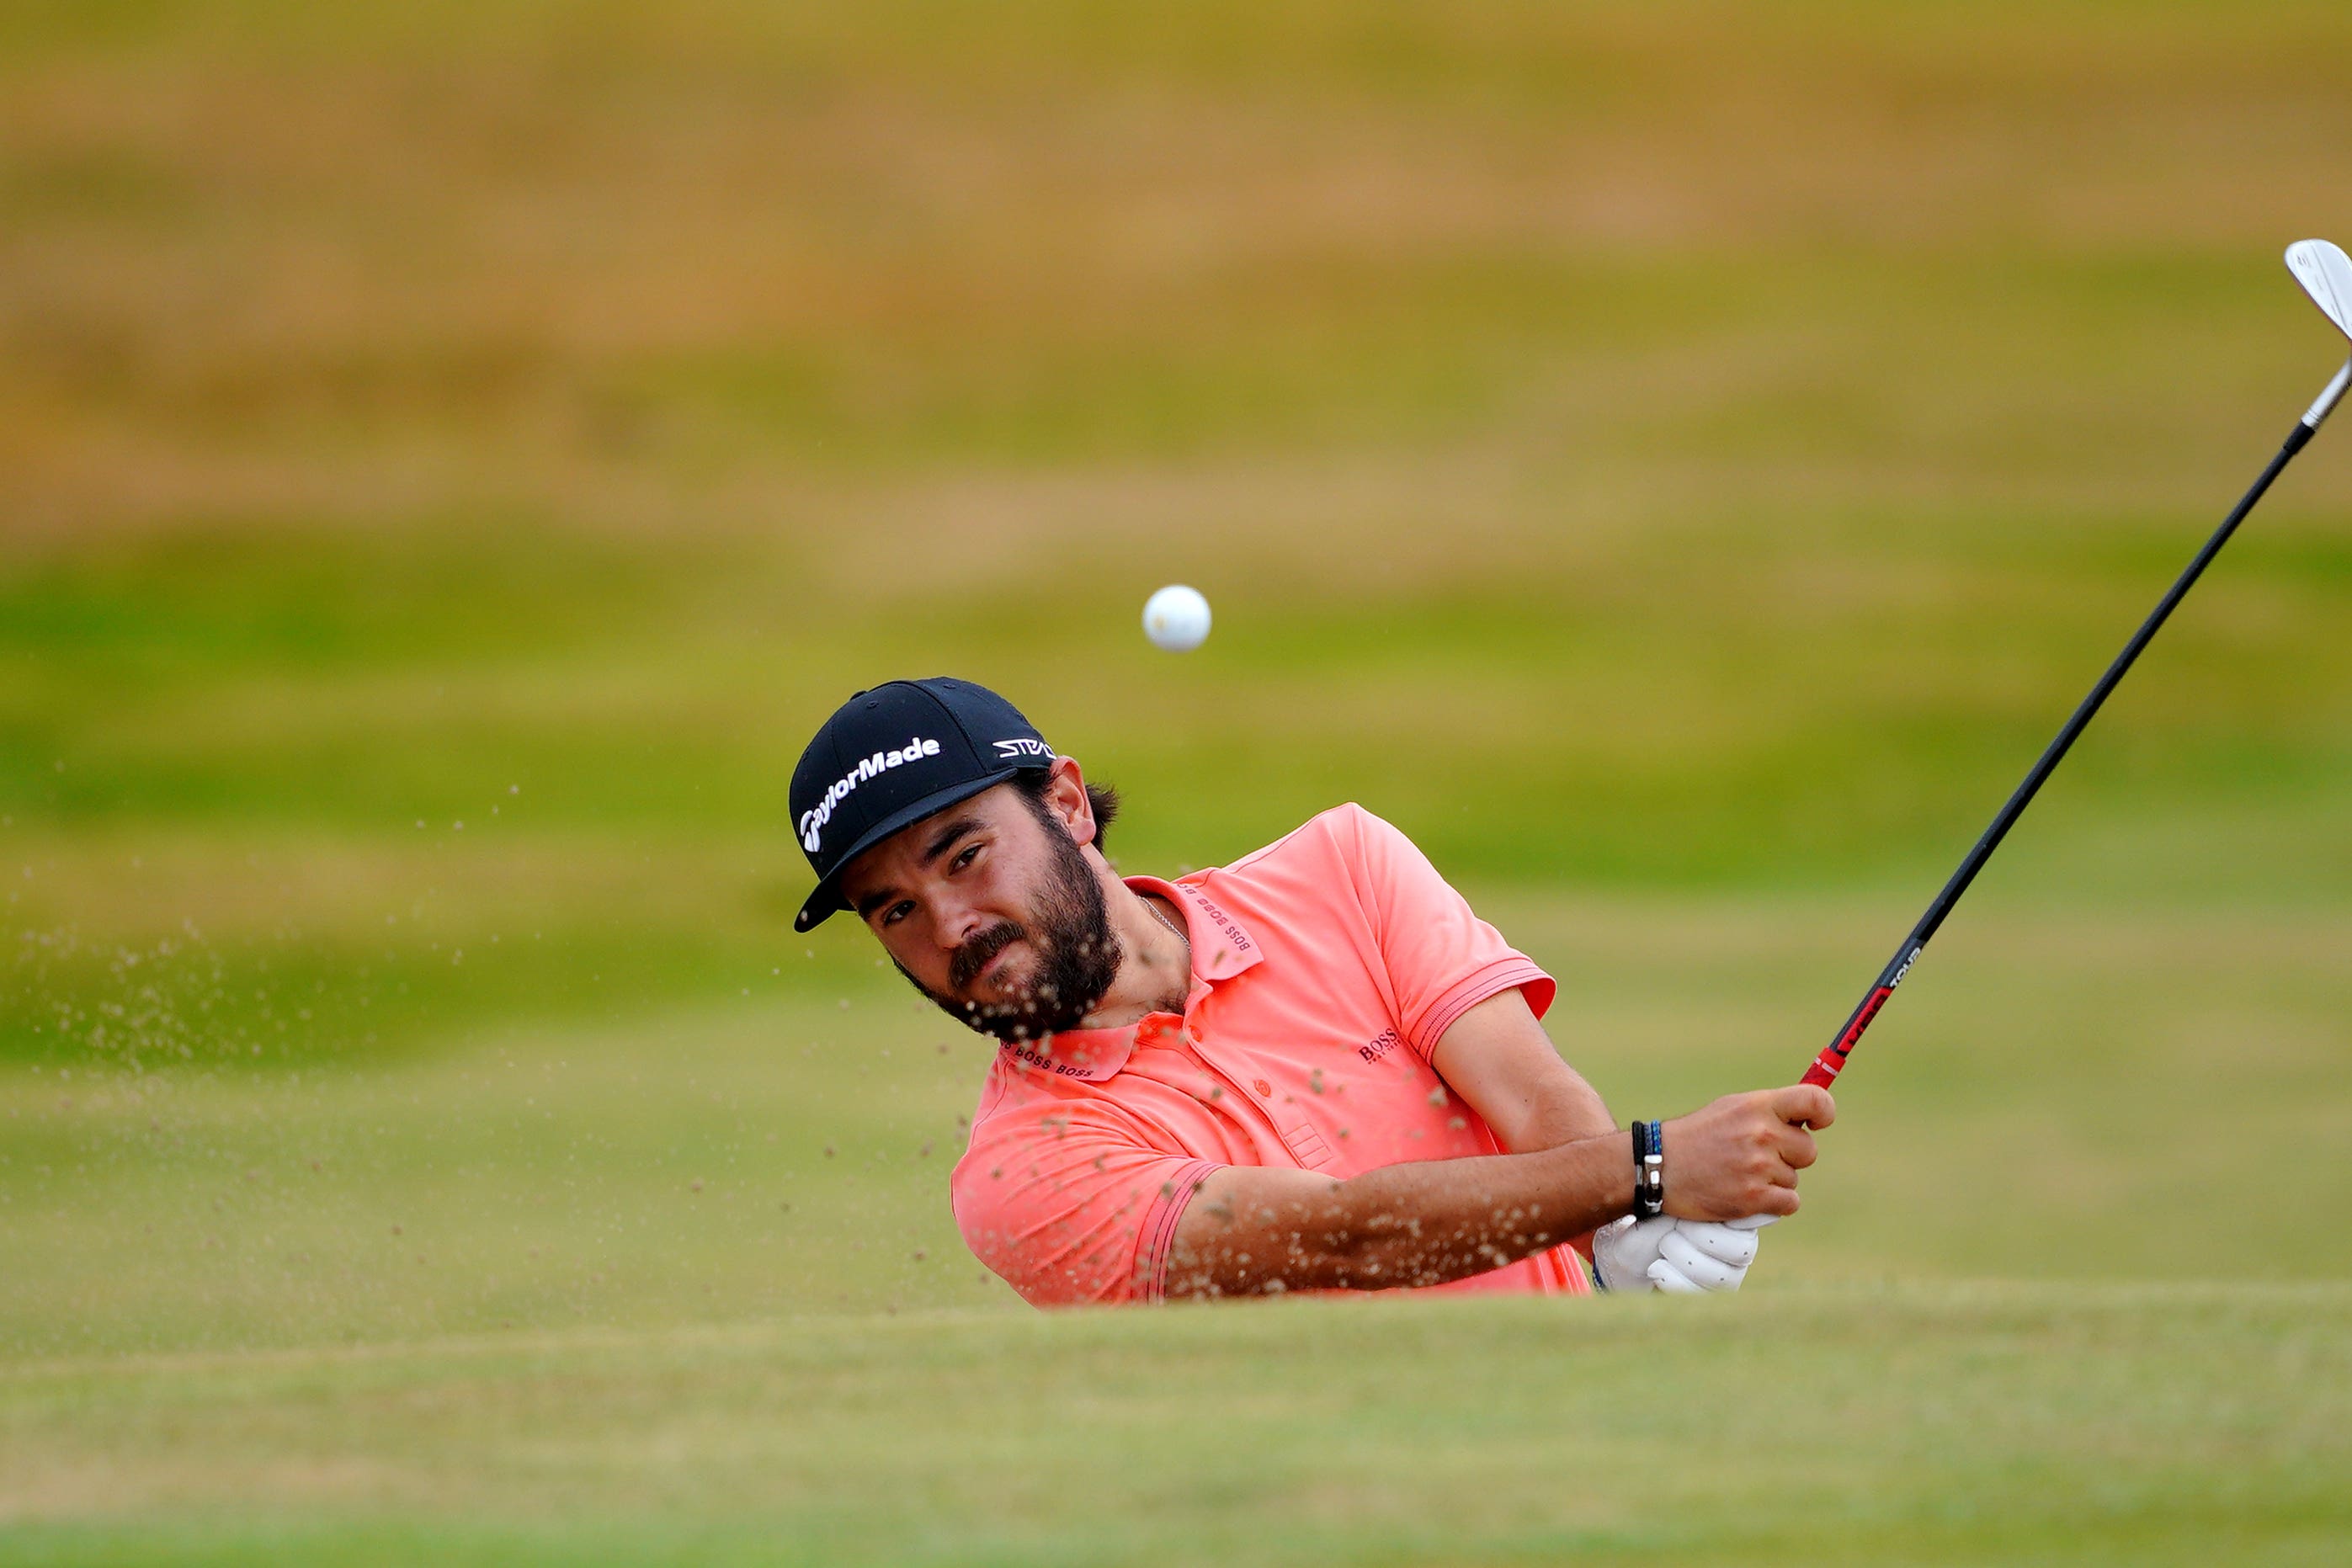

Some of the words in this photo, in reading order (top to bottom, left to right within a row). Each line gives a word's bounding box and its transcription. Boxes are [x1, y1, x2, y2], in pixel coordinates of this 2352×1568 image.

[800, 736, 940, 853] TaylorMade
[1225, 925, 1251, 951] BOSS
[1359, 1028, 1397, 1061] BOSS
[1015, 1047, 1052, 1070] BOSS
[1056, 1065, 1094, 1077] BOSS
